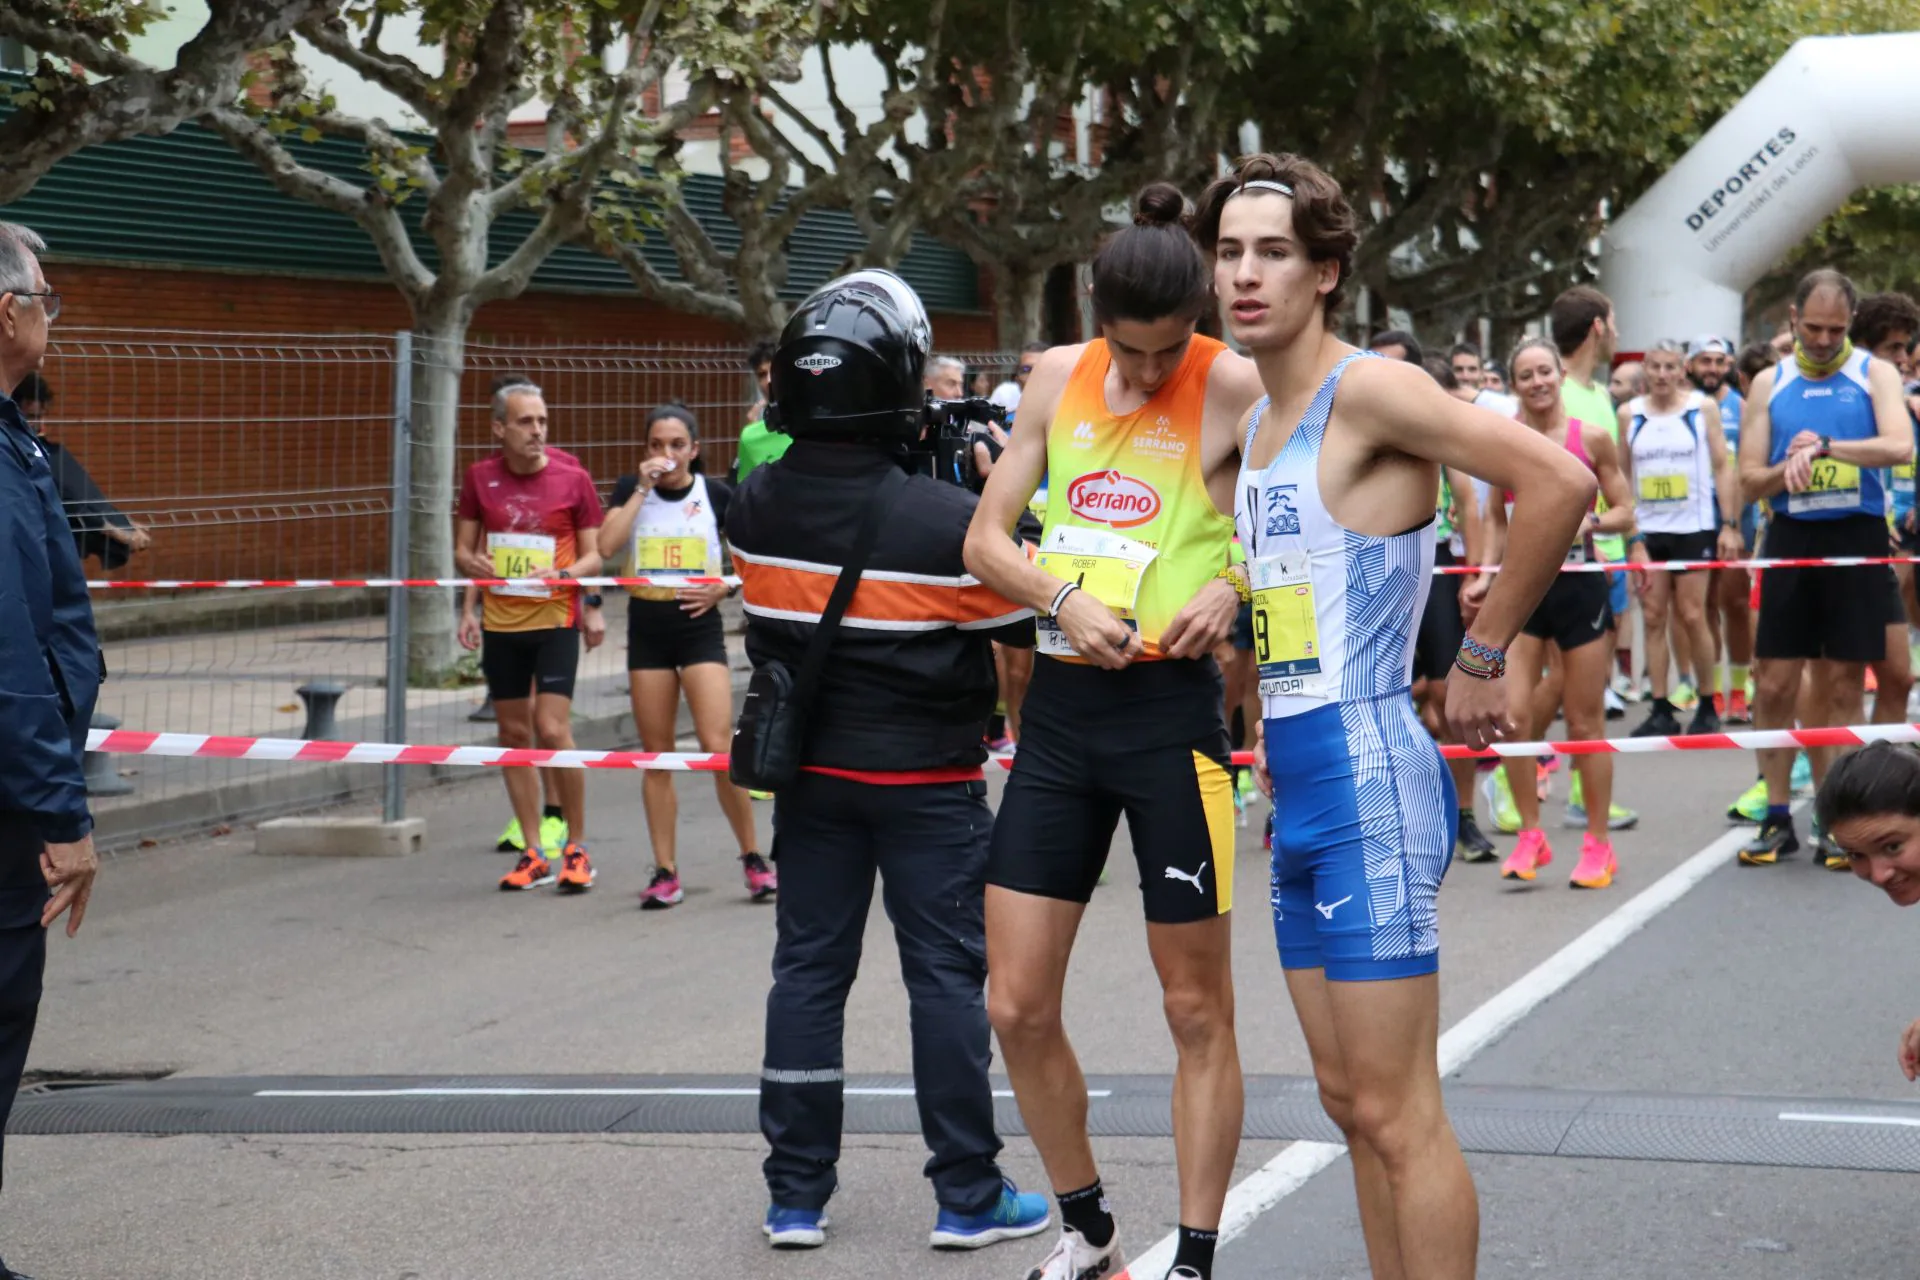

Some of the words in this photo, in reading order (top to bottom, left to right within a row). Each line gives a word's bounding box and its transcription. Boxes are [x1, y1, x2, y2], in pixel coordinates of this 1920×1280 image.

[1685, 127, 1796, 232] DEPORTES
[1703, 188, 1774, 253] Universidad
[1771, 174, 1788, 191] de
[796, 358, 839, 367] CABERG
[1133, 436, 1185, 453] SERRANO
[1073, 484, 1152, 513] Serrano
[1653, 481, 1671, 499] 70
[506, 555, 530, 577] 141
[663, 545, 682, 568] 16
[1071, 558, 1097, 569] ROBER
[1260, 678, 1304, 694] HYUNDAI
